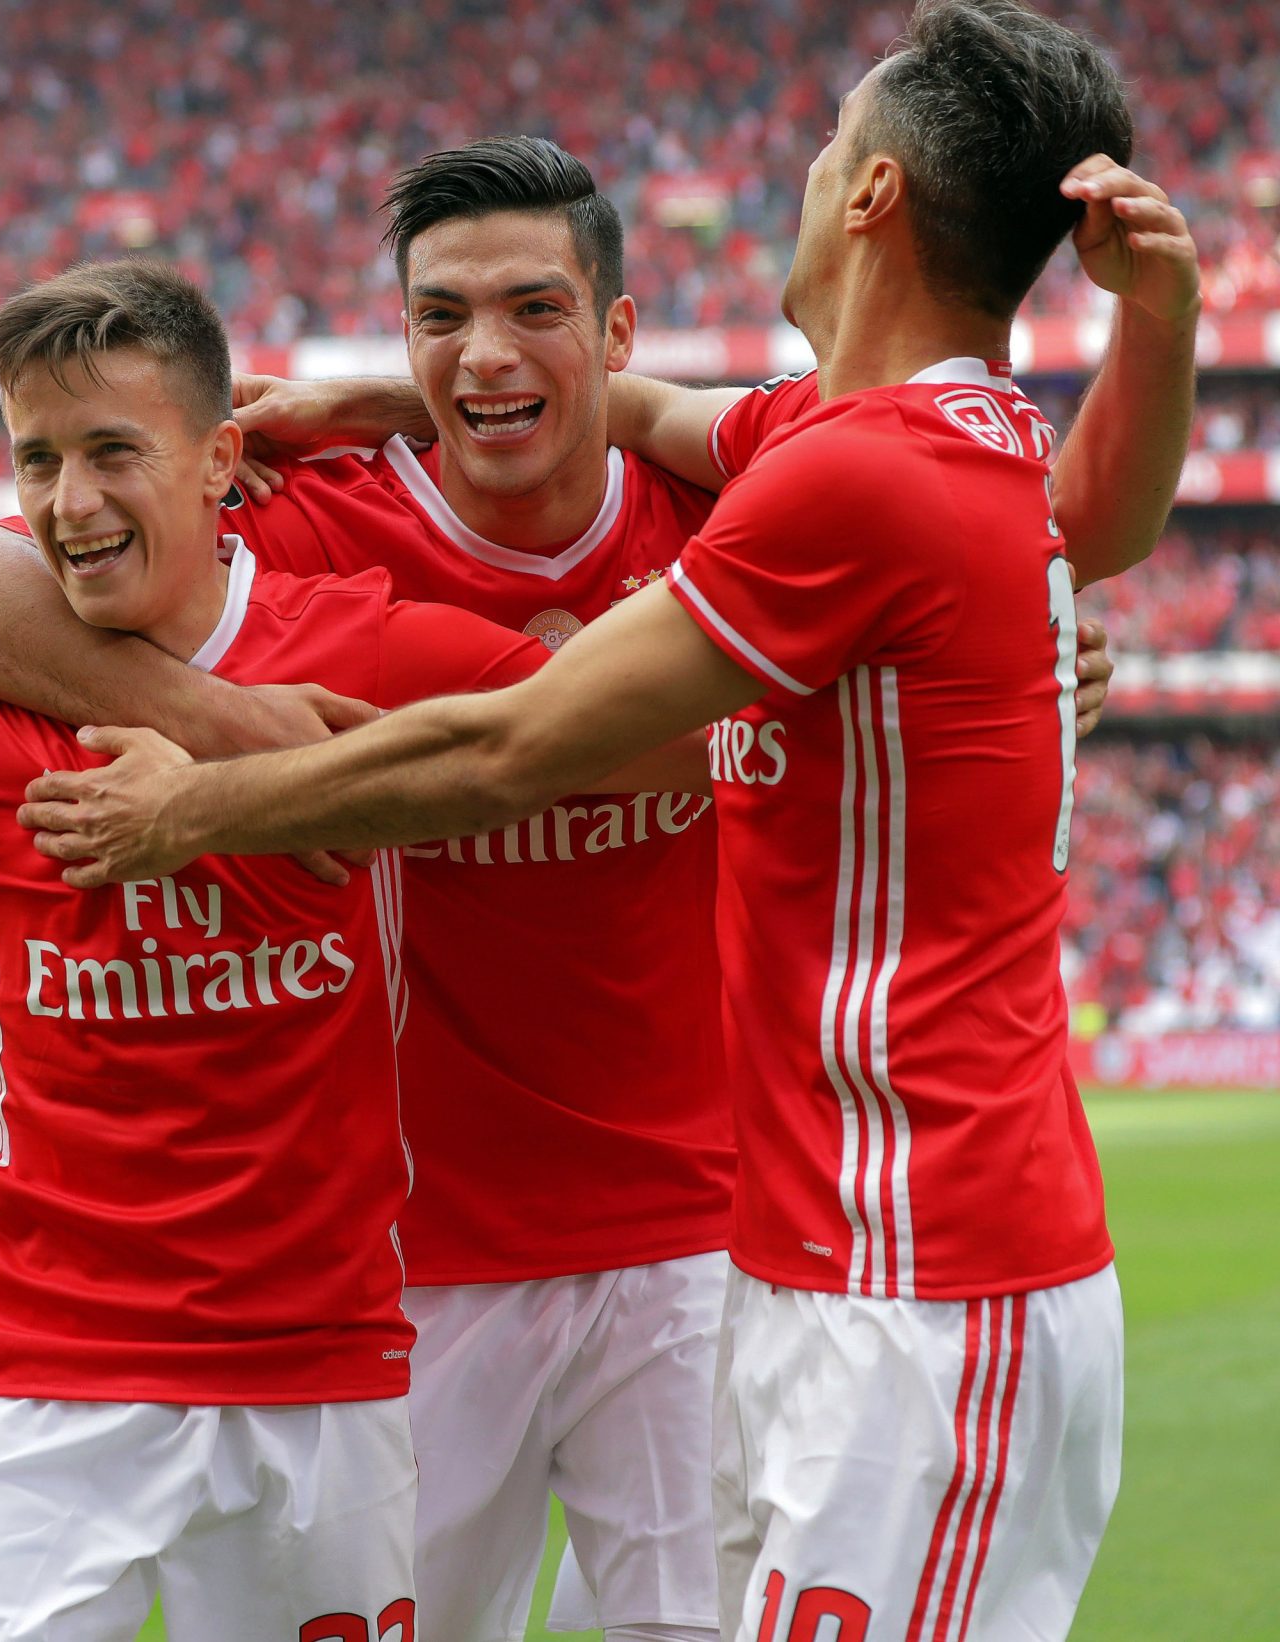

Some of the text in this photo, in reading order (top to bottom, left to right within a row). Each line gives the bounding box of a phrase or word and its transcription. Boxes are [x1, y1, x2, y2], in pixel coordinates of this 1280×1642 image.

[402, 792, 714, 865] mirate
[123, 876, 221, 939] Fly
[23, 932, 355, 1020] Emirates
